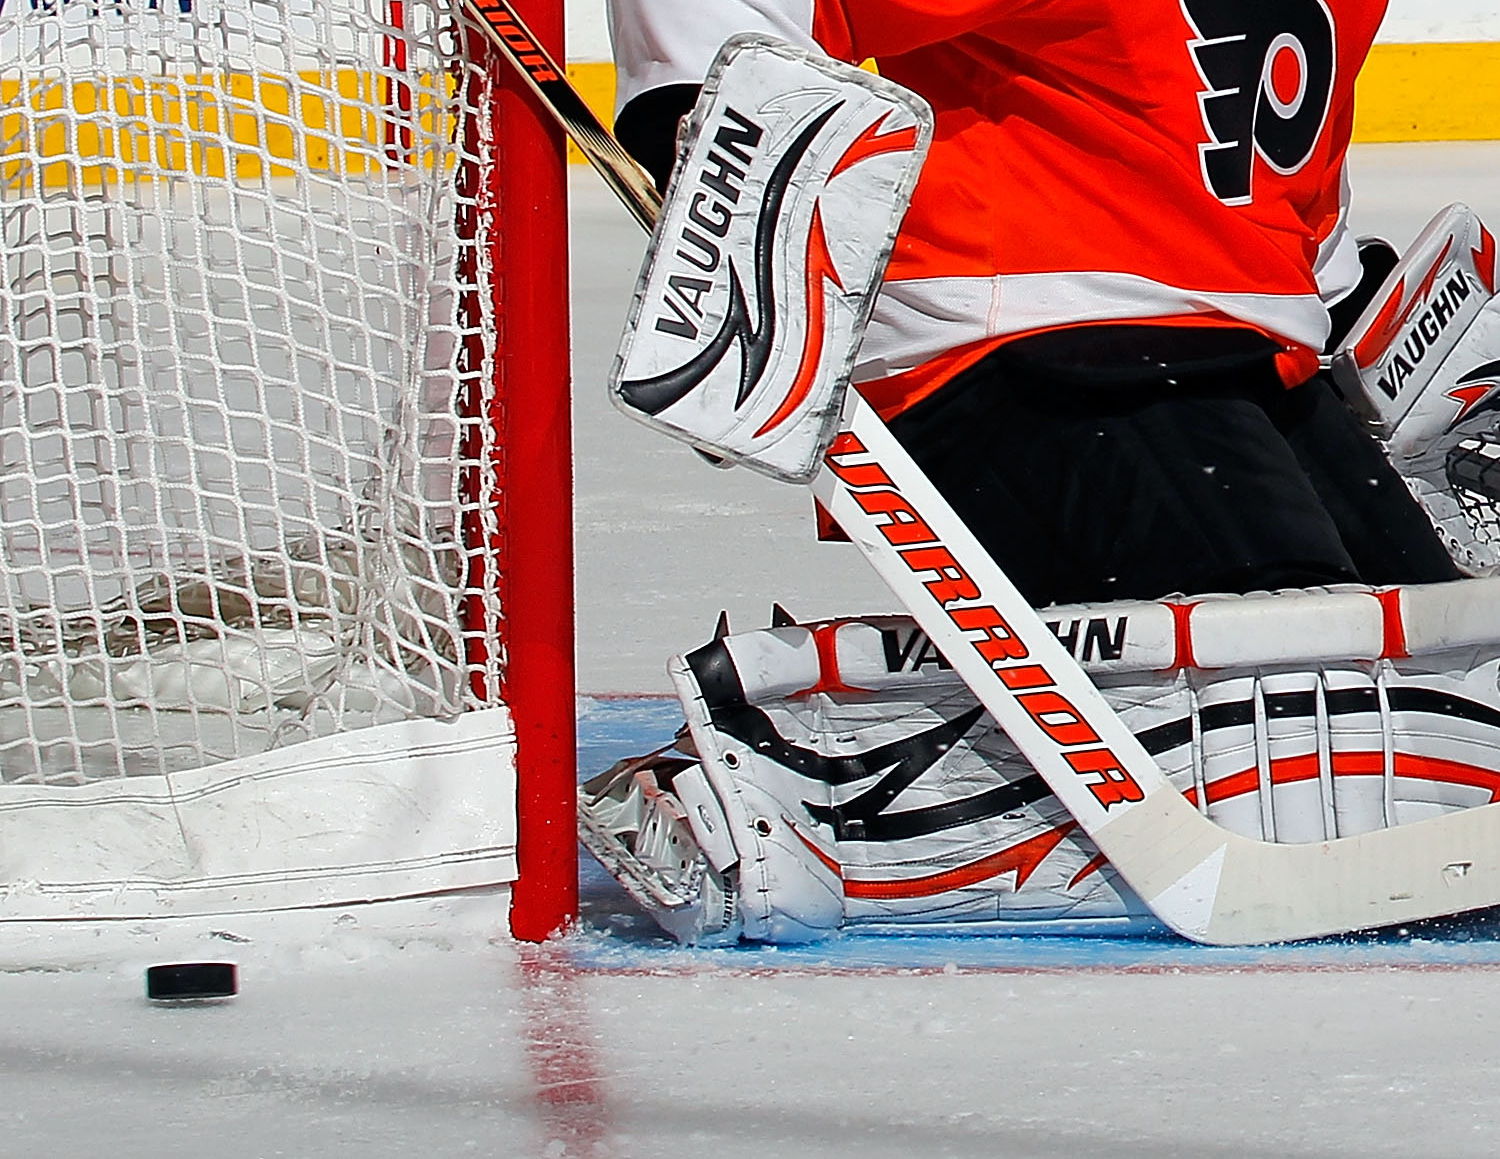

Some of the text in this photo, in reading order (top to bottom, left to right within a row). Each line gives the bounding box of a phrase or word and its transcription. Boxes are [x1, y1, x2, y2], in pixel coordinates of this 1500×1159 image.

[654, 106, 764, 342] VAUGHN
[1375, 269, 1471, 402] VAUGHN
[880, 615, 1129, 674] VAHN
